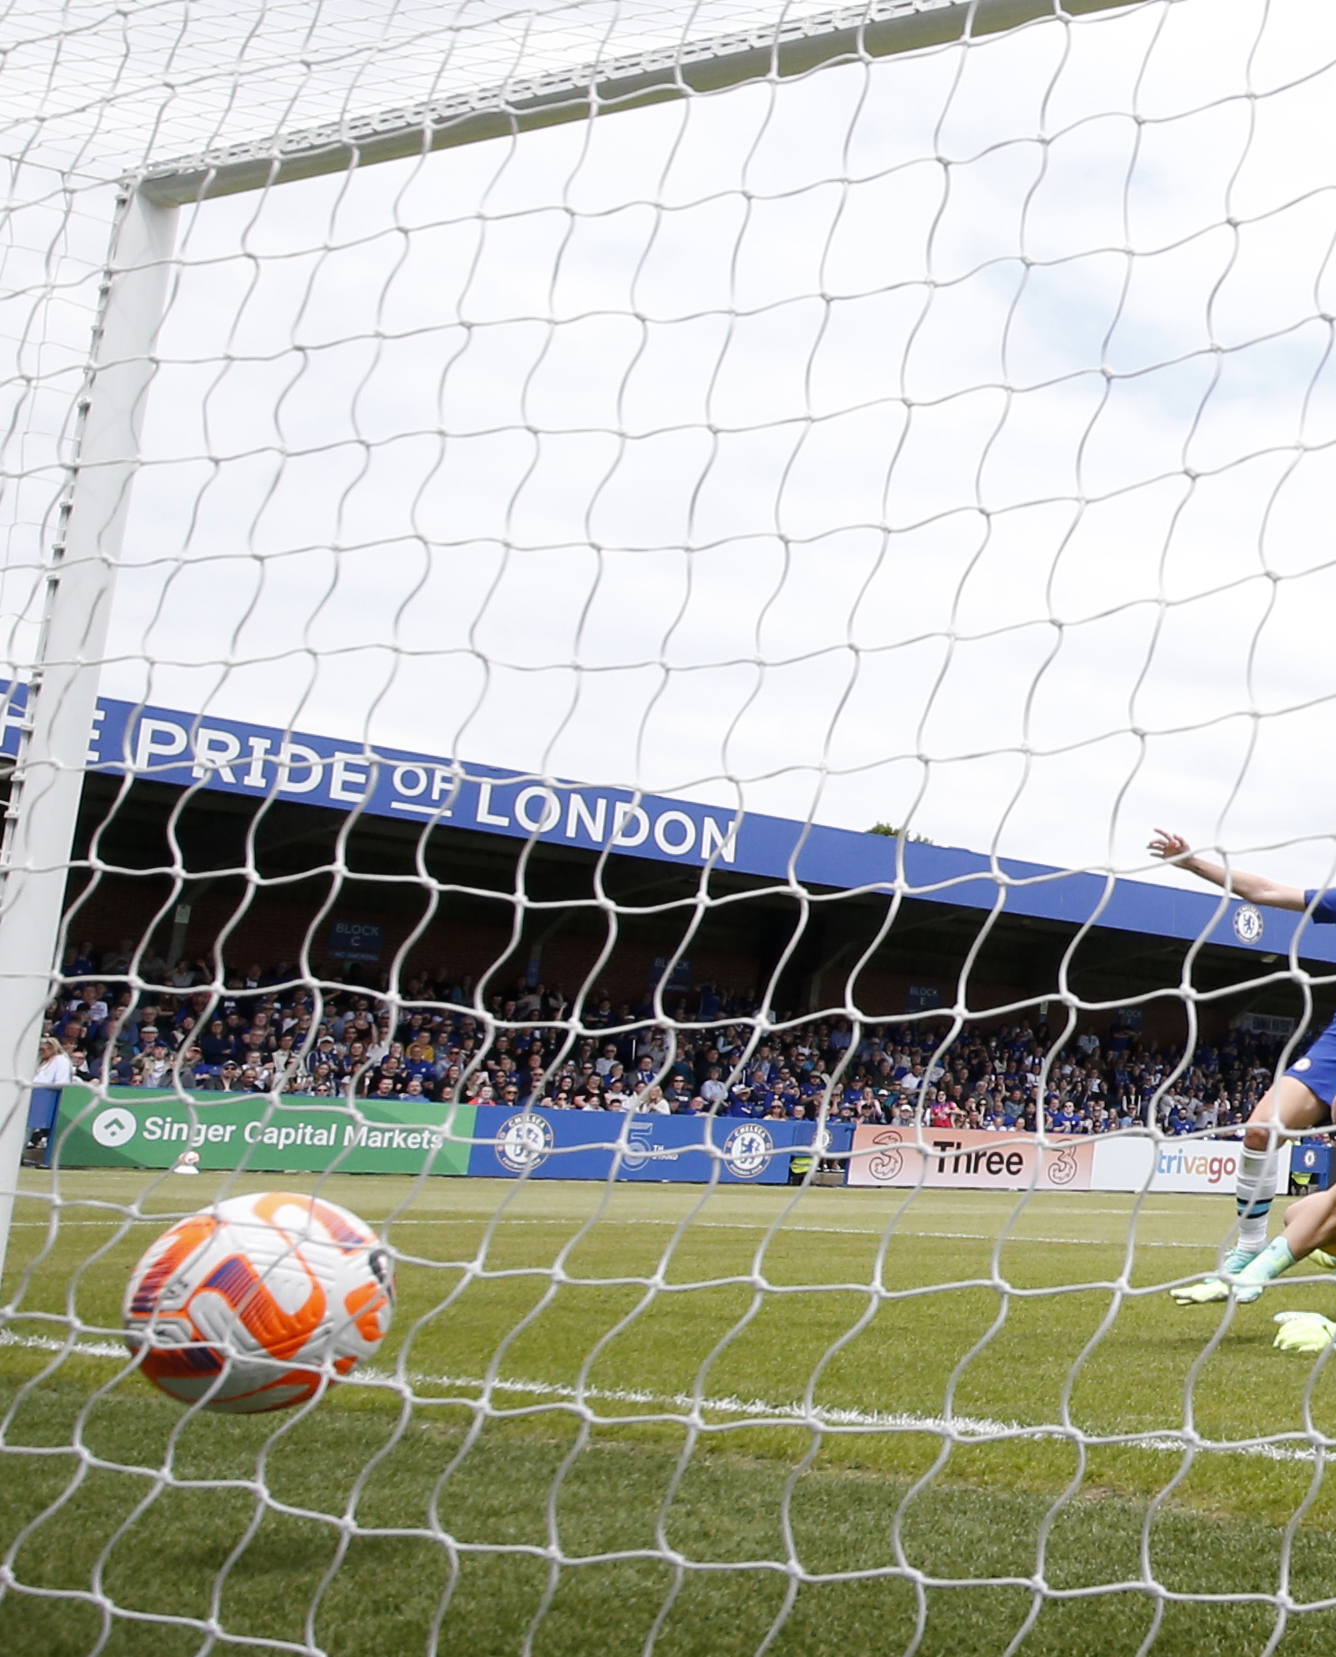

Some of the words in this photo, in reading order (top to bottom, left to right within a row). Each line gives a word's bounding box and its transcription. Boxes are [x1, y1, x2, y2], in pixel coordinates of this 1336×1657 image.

[135, 717, 371, 803] PRIDE
[392, 765, 455, 801] OF
[476, 780, 737, 864] LONDON
[335, 922, 380, 937] BLOCK
[142, 1117, 236, 1145] Singer
[243, 1121, 335, 1150] Capital
[342, 1126, 444, 1150] Markets
[933, 1141, 1023, 1176] Three
[1156, 1148, 1236, 1184] trivago
